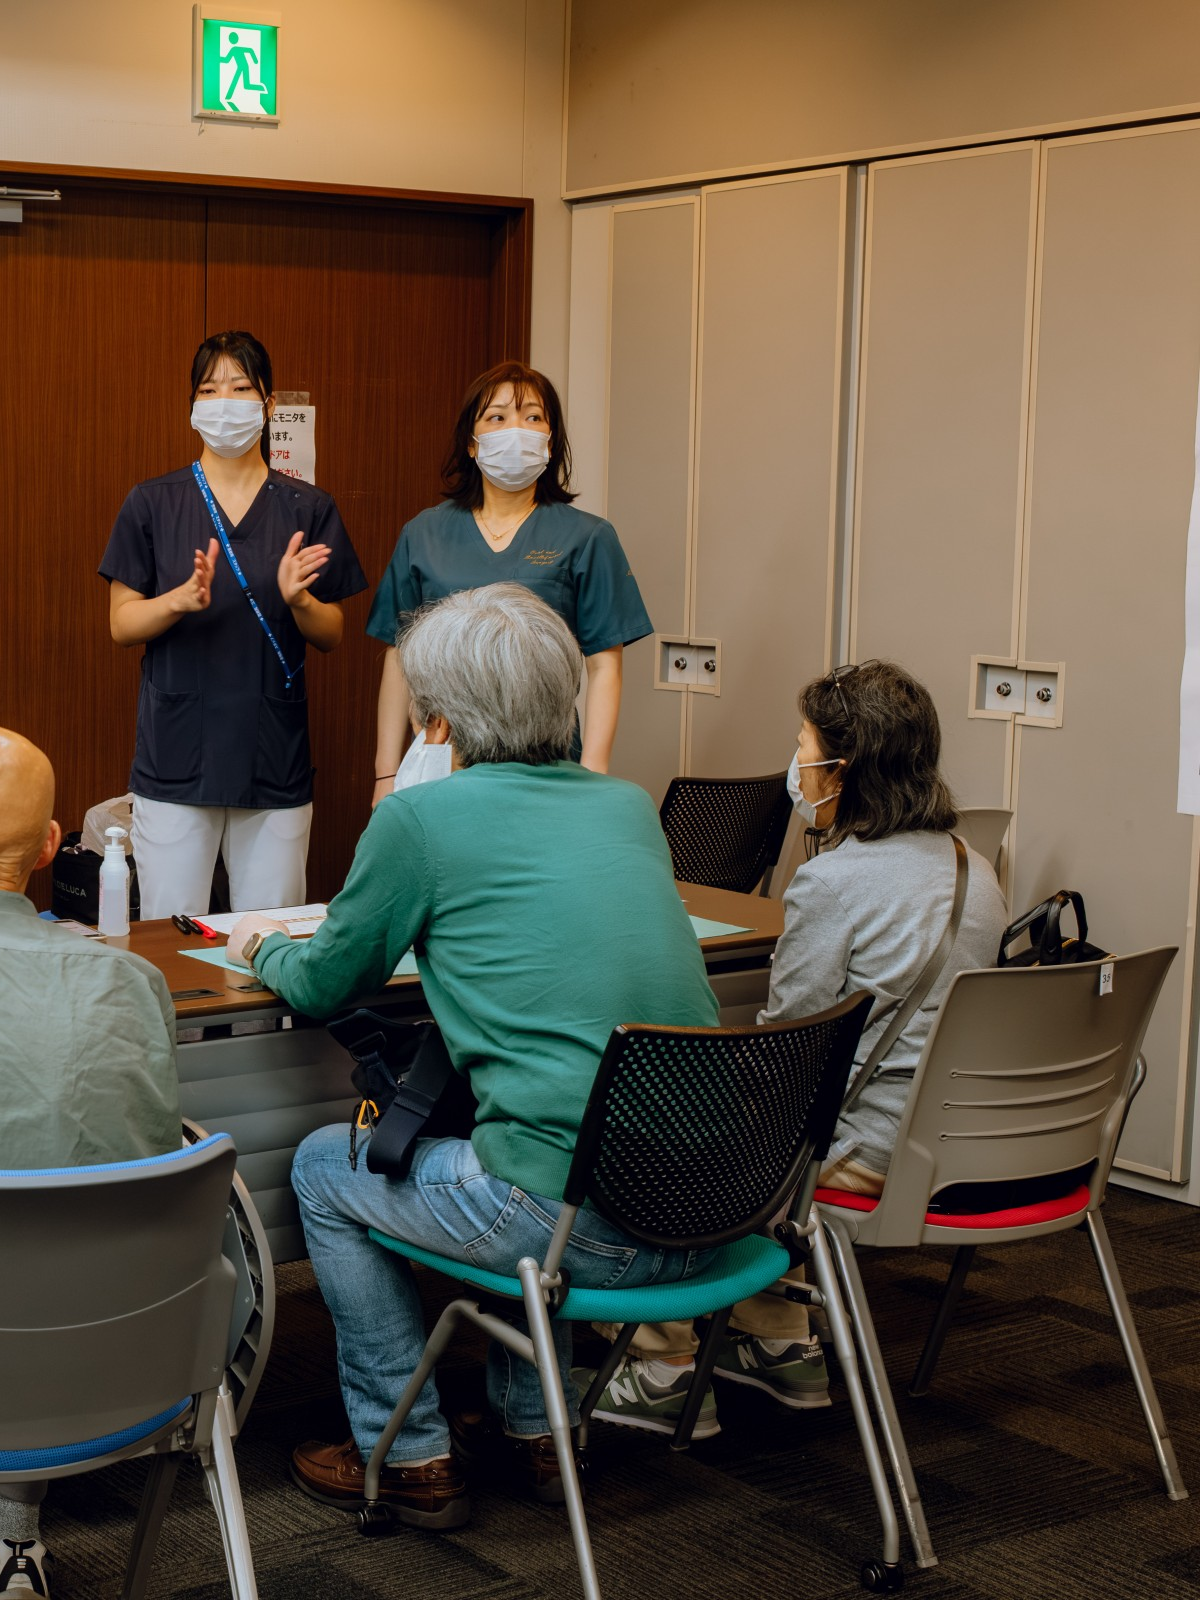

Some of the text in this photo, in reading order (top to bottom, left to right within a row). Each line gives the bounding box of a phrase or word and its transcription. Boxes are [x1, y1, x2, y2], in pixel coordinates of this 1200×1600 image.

[269, 413, 306, 423] にモニタを
[737, 1344, 759, 1370] N
[609, 1377, 639, 1407] N
